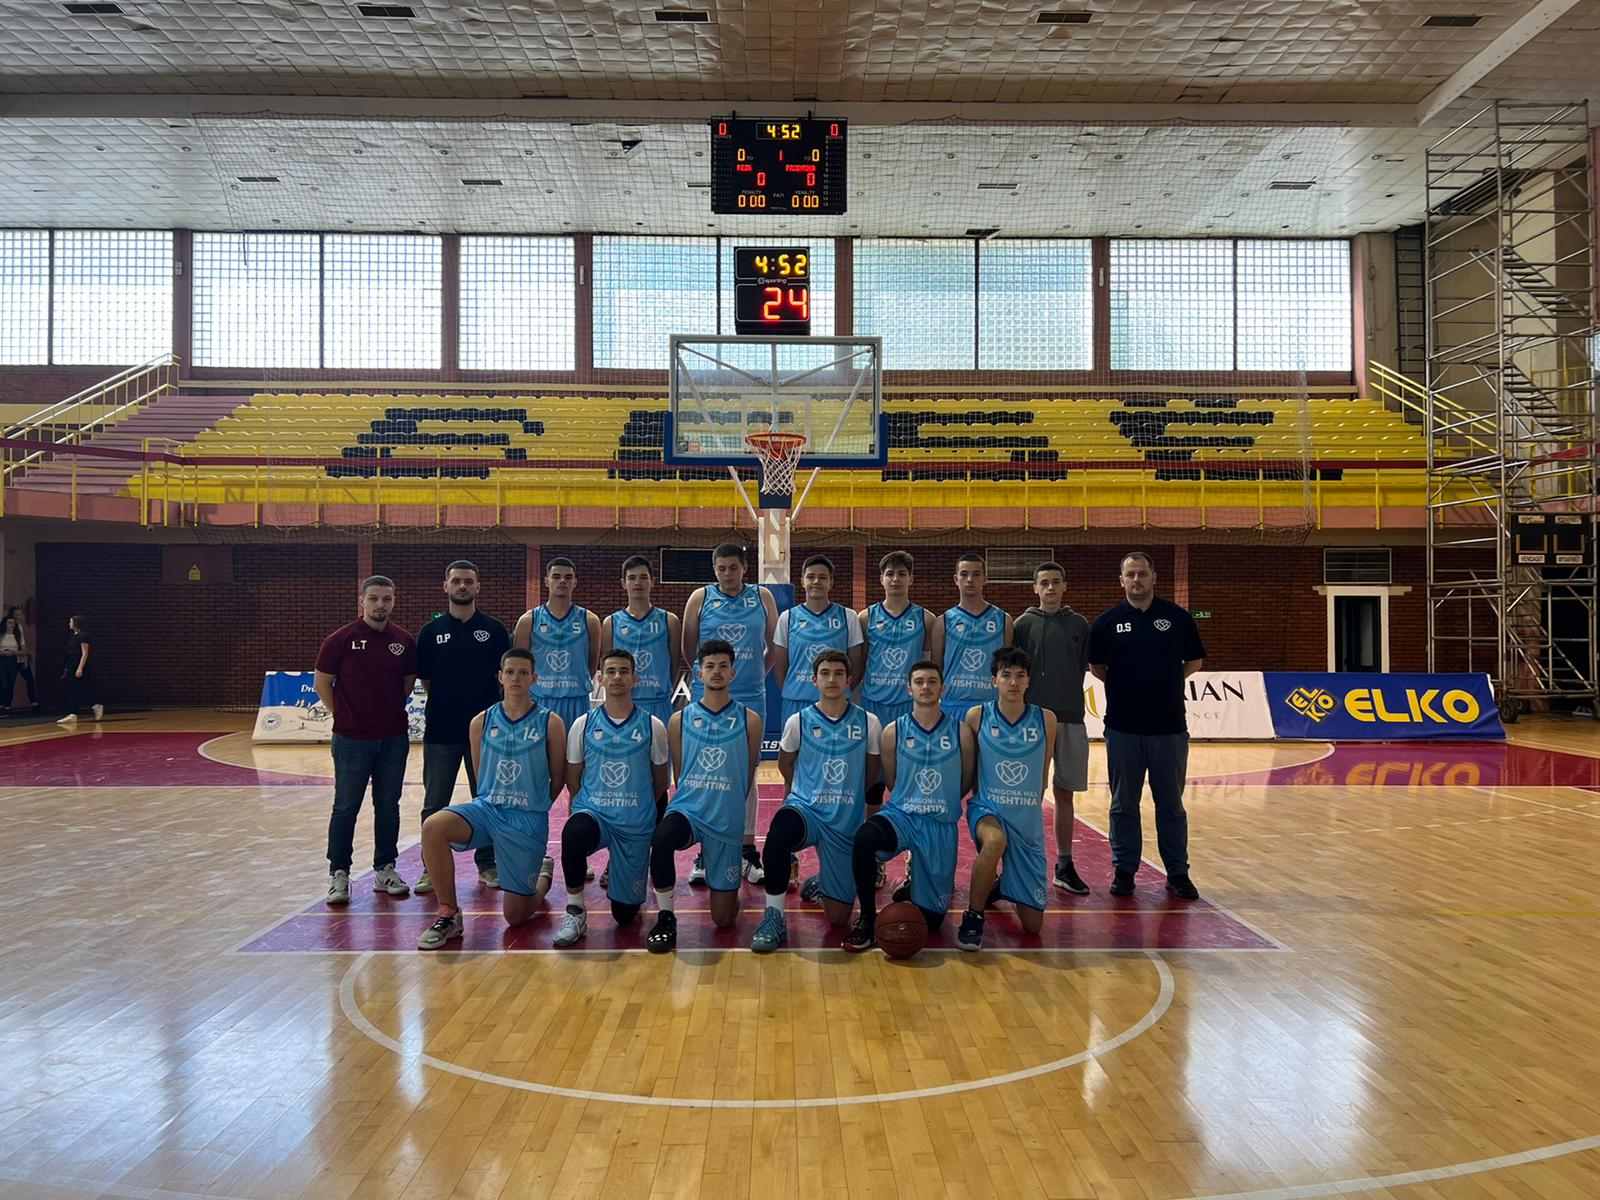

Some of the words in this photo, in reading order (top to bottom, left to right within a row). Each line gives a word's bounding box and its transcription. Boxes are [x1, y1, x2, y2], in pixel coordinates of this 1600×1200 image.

[719, 122, 727, 136] 0
[767, 124, 800, 139] 4:52
[831, 123, 839, 137] 0
[737, 148, 746, 162] 0
[811, 148, 820, 162] 0
[757, 171, 766, 186] 0
[806, 172, 816, 186] 0
[755, 254, 807, 275] 4:52
[763, 287, 807, 319] 24
[743, 597, 757, 608] 15
[648, 621, 659, 633] 11
[828, 617, 841, 629] 10
[905, 619, 915, 631] 9
[986, 620, 996, 633] 8
[1184, 680, 1246, 701] IAN
[1344, 688, 1480, 723] ELKO
[727, 716, 737, 730] 7
[522, 726, 541, 742] 14
[631, 728, 642, 742] 4
[847, 724, 862, 740] 12
[1022, 727, 1039, 742] 13
[940, 735, 952, 750] 6
